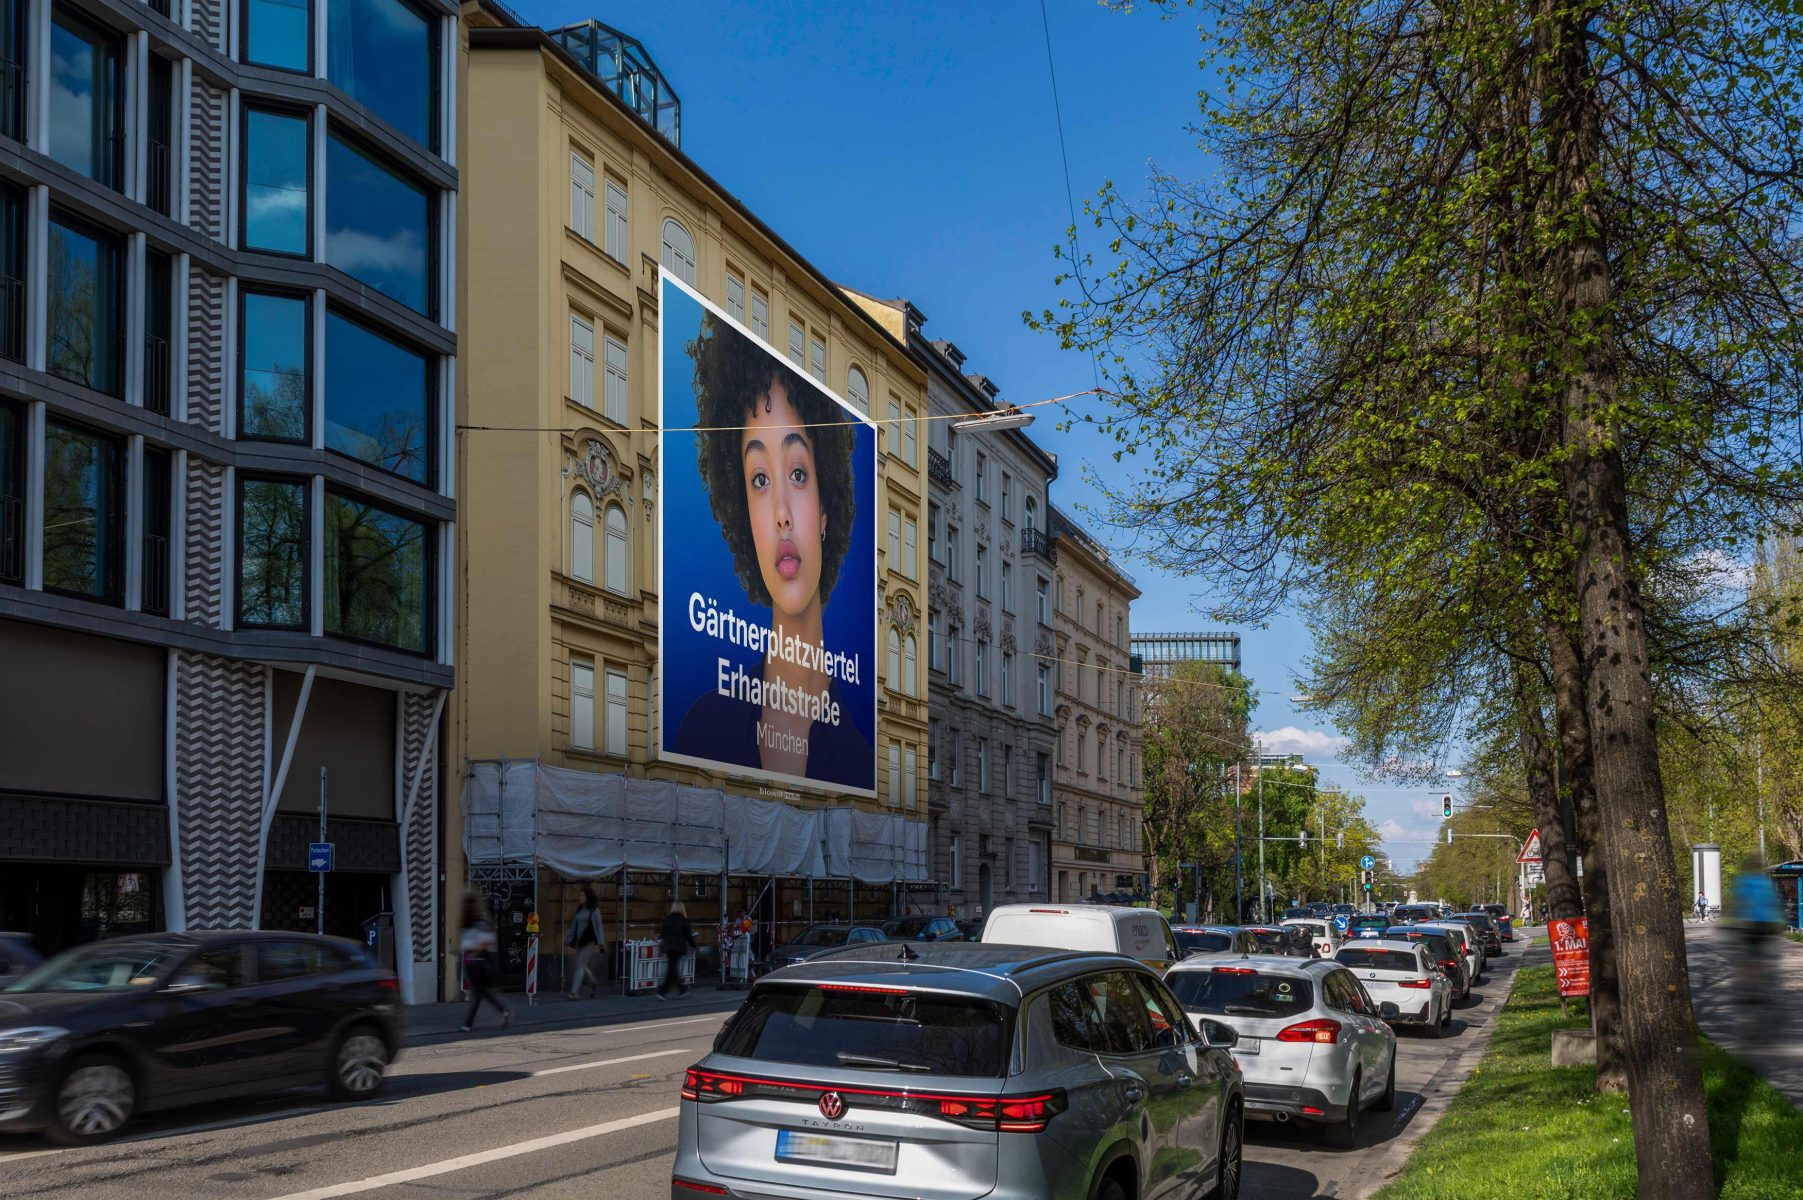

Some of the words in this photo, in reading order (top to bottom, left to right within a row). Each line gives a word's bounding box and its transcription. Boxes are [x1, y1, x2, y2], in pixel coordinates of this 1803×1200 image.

[688, 591, 860, 685] Gärtnerplatzviertel
[717, 657, 840, 727] Erhardtstraße
[756, 721, 809, 756] München
[1565, 937, 1587, 951] MAI
[801, 1119, 864, 1131] TAYRON
